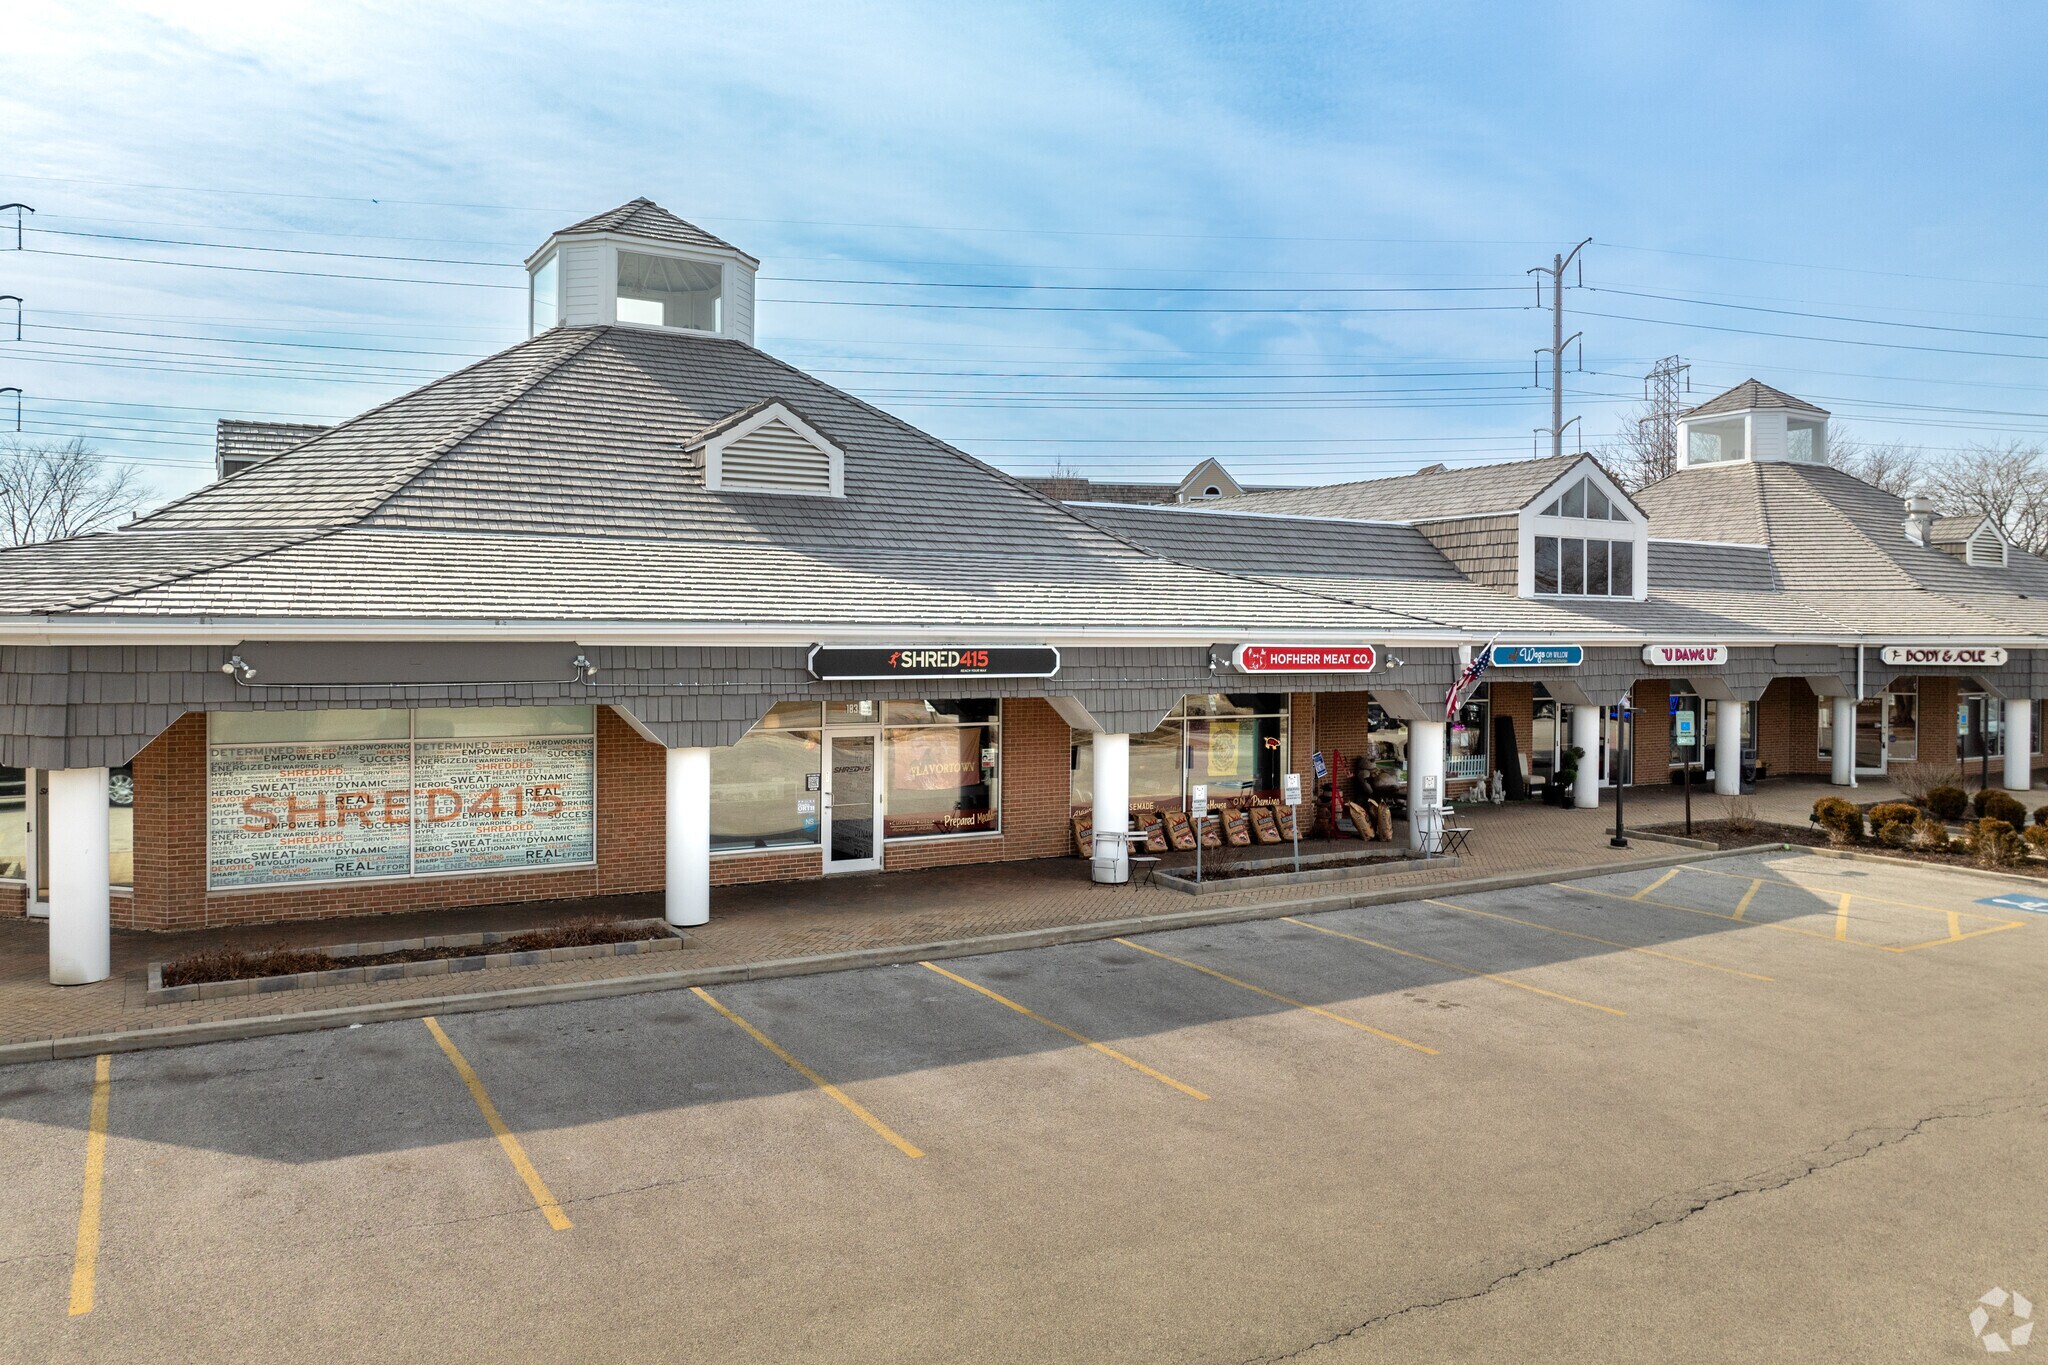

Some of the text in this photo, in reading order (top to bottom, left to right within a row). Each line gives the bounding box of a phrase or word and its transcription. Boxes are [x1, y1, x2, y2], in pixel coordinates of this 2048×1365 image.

[1270, 653, 1371, 665] HOFHERR MEAT CO.
[1675, 648, 1705, 661] DAWG
[1906, 650, 1986, 662] BODY & SOLE
[901, 651, 989, 668] SHRED415
[415, 742, 489, 750] DETERMINED
[212, 747, 294, 756] DETERMINED
[462, 748, 527, 756] EMPOWERED
[264, 753, 336, 762] EMPOWERED
[359, 755, 410, 763] SUCCESS
[212, 764, 270, 772] ENERGIZED
[476, 762, 532, 770] SHREDDED
[833, 766, 872, 774] SHRED415
[279, 768, 343, 777] SHREDDED
[298, 775, 354, 783] HEARTFELT
[450, 775, 491, 784] SWEAT
[251, 783, 296, 792] SWEAT
[336, 780, 387, 788] DYNAMIC
[454, 782, 520, 790] REVOLUTIONARY
[255, 790, 329, 799] REVOLUTIONARY
[526, 788, 561, 796] REAL
[336, 795, 374, 804] REAL
[1233, 797, 1246, 806] ON
[1251, 794, 1280, 807] Premises
[242, 784, 562, 832] SHRED415
[1130, 802, 1154, 811] SEMADE
[212, 807, 288, 816] HIGH-NERGY
[339, 810, 410, 818] HARDWORKING
[462, 810, 527, 819] EMPOWERED
[548, 811, 593, 819] SUCCESS
[264, 820, 336, 830] EMPOWERED
[359, 821, 410, 830] SUCCESS
[416, 821, 468, 829] ENERGIZED
[944, 814, 975, 828] Prepared
[476, 824, 533, 833] SHREDDED
[212, 832, 271, 840] ENERGIZED
[280, 835, 343, 845] SHREDDED
[527, 835, 573, 843] DYNAMIC
[298, 842, 354, 850] HEARTFELT
[451, 838, 491, 848] SWEAT
[336, 846, 387, 855] DYNAMIC
[454, 845, 521, 853] REVOLUTIONARY
[251, 851, 296, 860] SWEAT
[526, 850, 561, 859] REAL
[255, 857, 329, 866] REVOLUTIONARY
[336, 862, 374, 872] REAL
[415, 862, 483, 871] HIGH-ENERGY
[211, 875, 287, 885] HIGH-ENERGY
